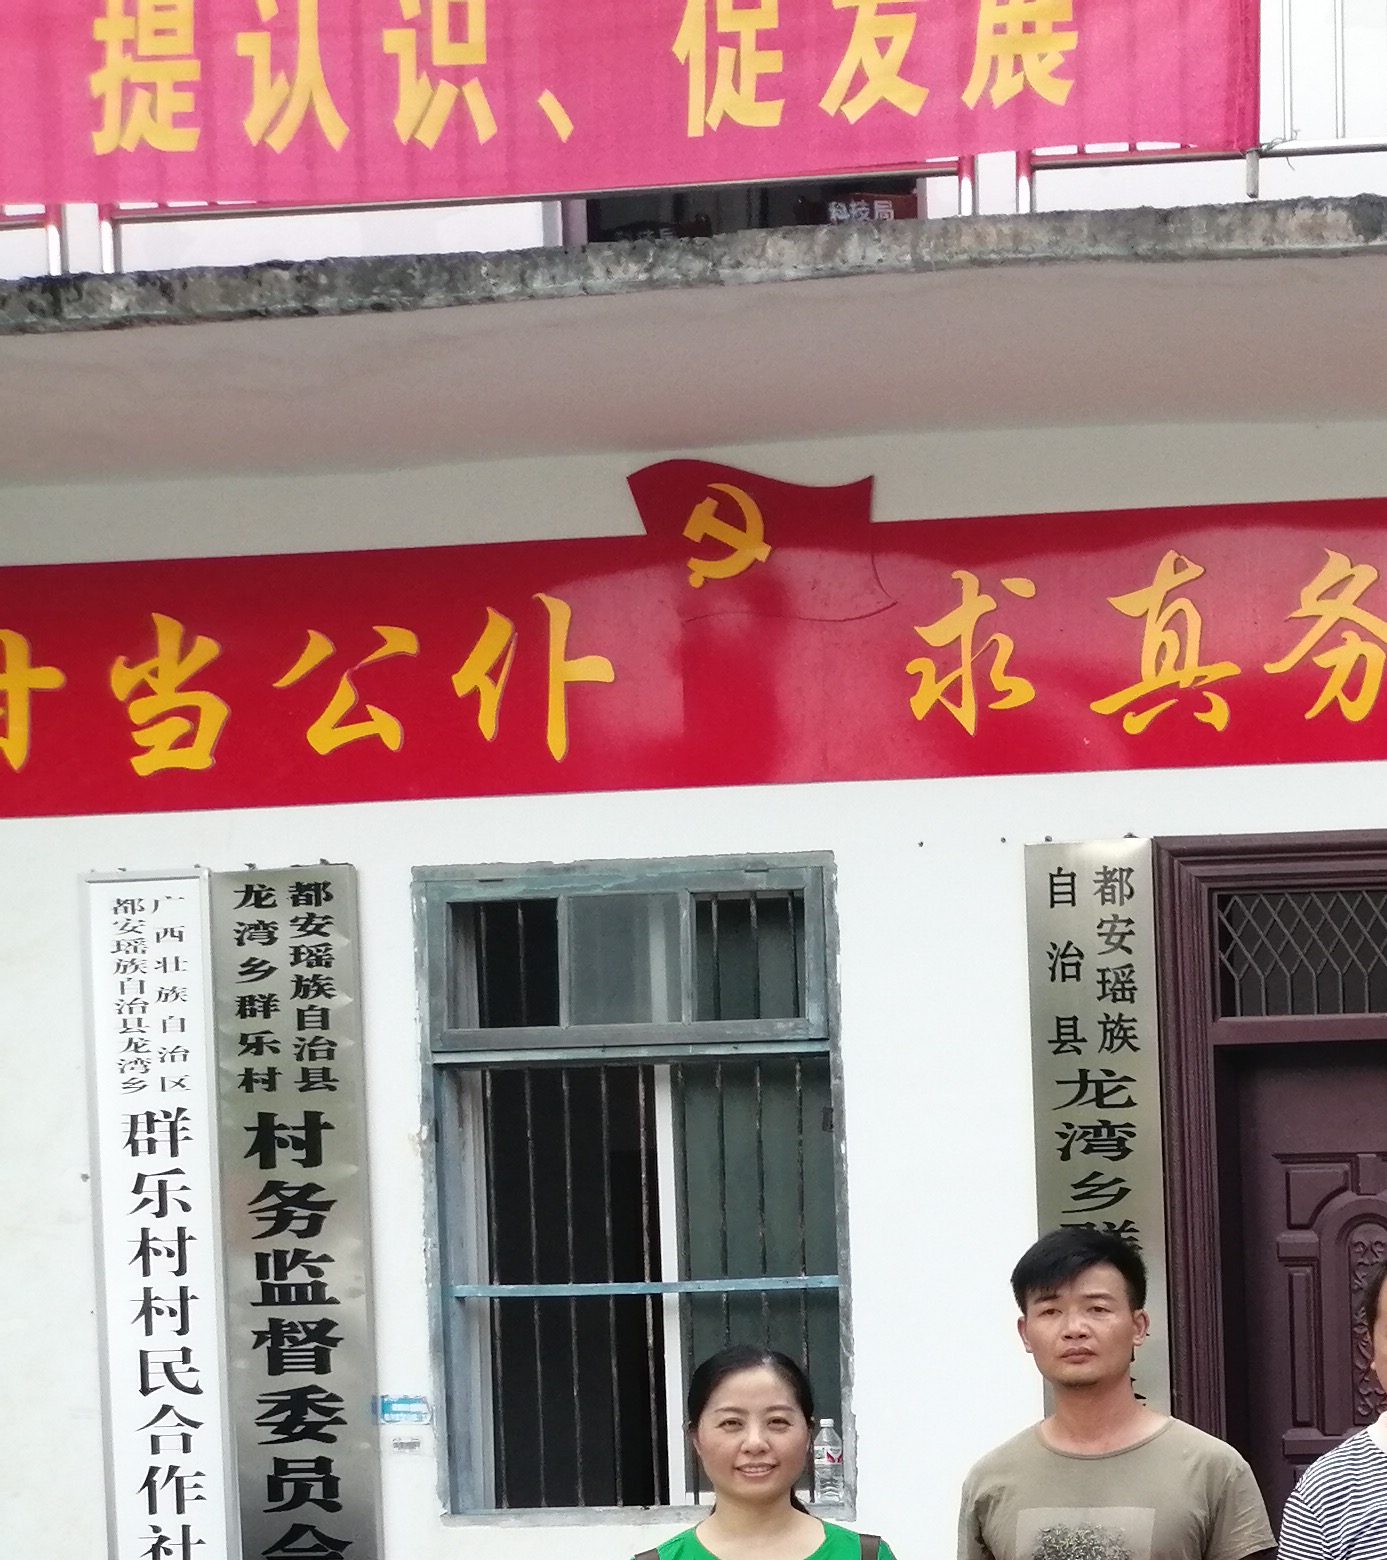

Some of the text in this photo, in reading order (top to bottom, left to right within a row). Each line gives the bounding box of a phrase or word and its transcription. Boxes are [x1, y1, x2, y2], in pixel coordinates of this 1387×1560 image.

[111, 898, 150, 1095] 都安瑶族自治县龙湾乡
[152, 895, 192, 1093] 广西壮族自治区
[233, 884, 283, 1094] 龙湾乡群乐村
[288, 880, 339, 1094] 都安瑶族自治县
[1048, 866, 1088, 1056] 自治县
[1094, 865, 1141, 1054] 都安瑶族
